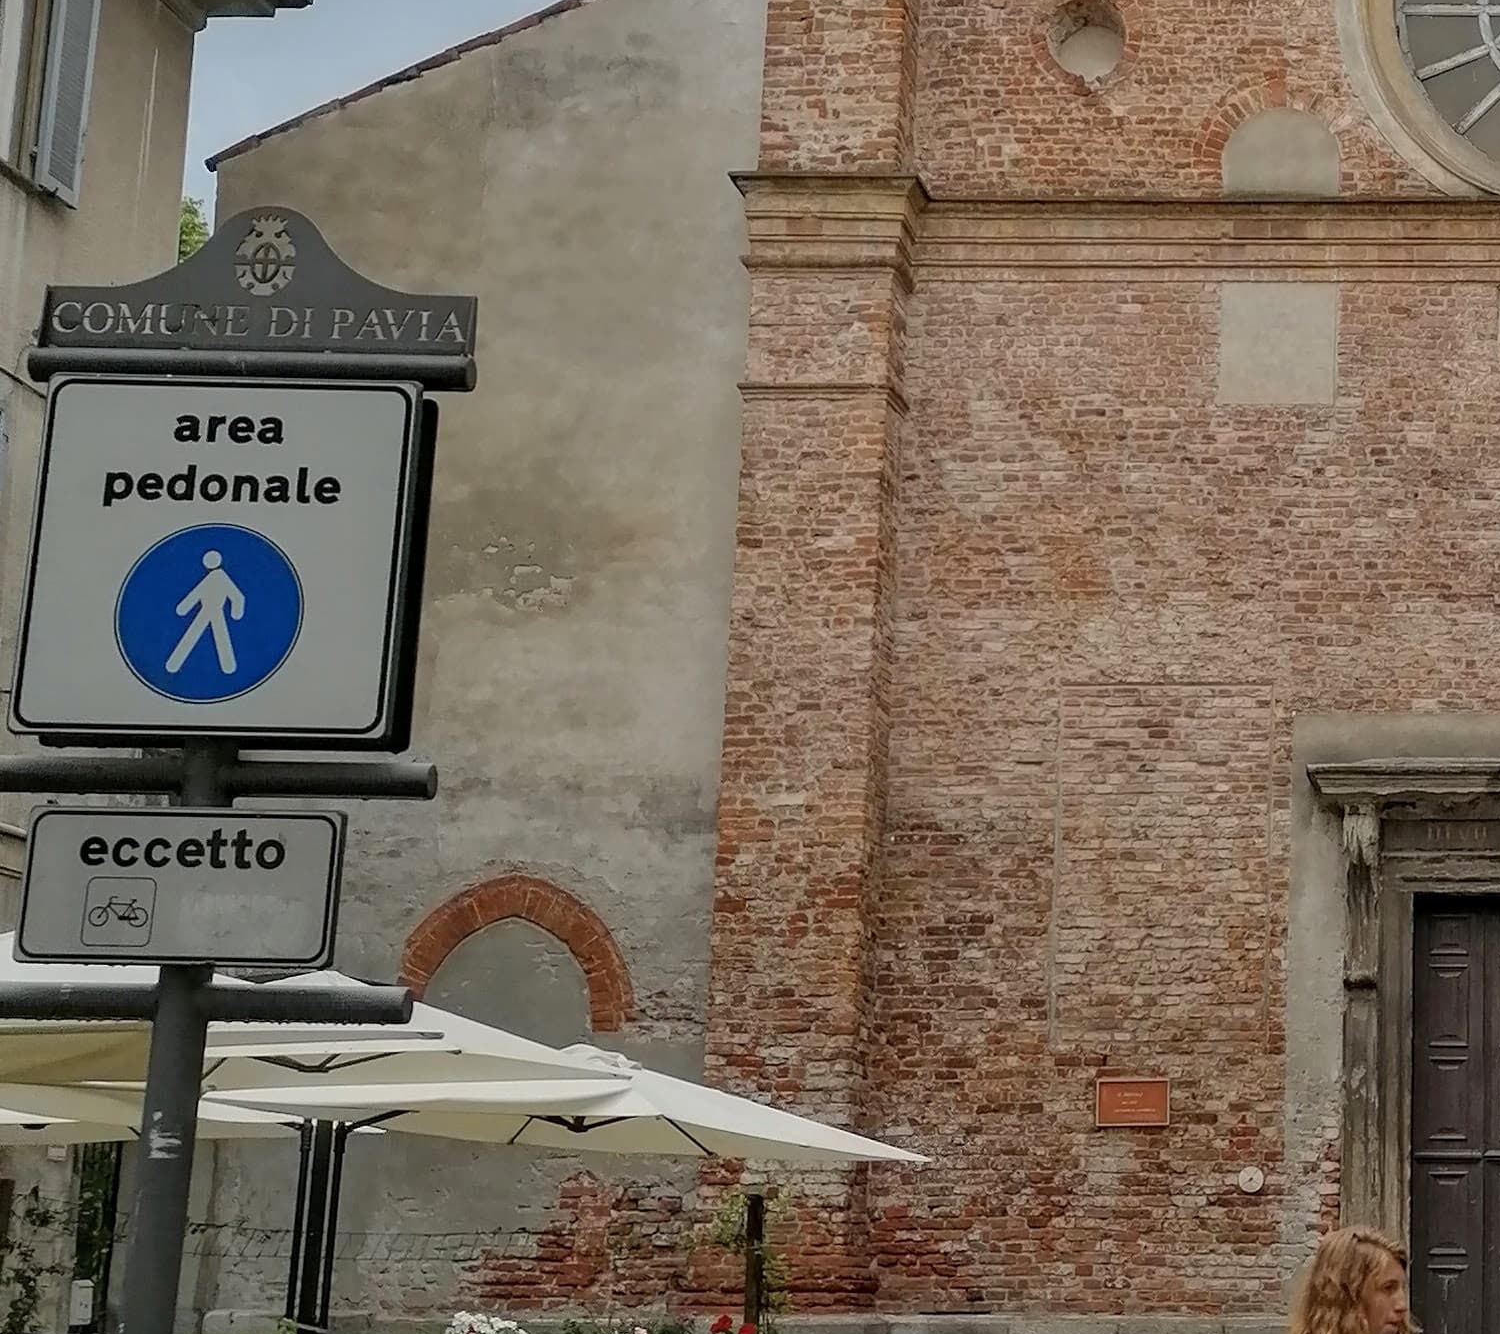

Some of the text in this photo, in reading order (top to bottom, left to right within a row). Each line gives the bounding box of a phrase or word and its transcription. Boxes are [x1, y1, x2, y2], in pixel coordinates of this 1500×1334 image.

[51, 301, 467, 344] COMUNE DI PAVIA
[173, 414, 284, 445] area
[102, 464, 341, 507] pedonale
[80, 827, 285, 870] eccetto
